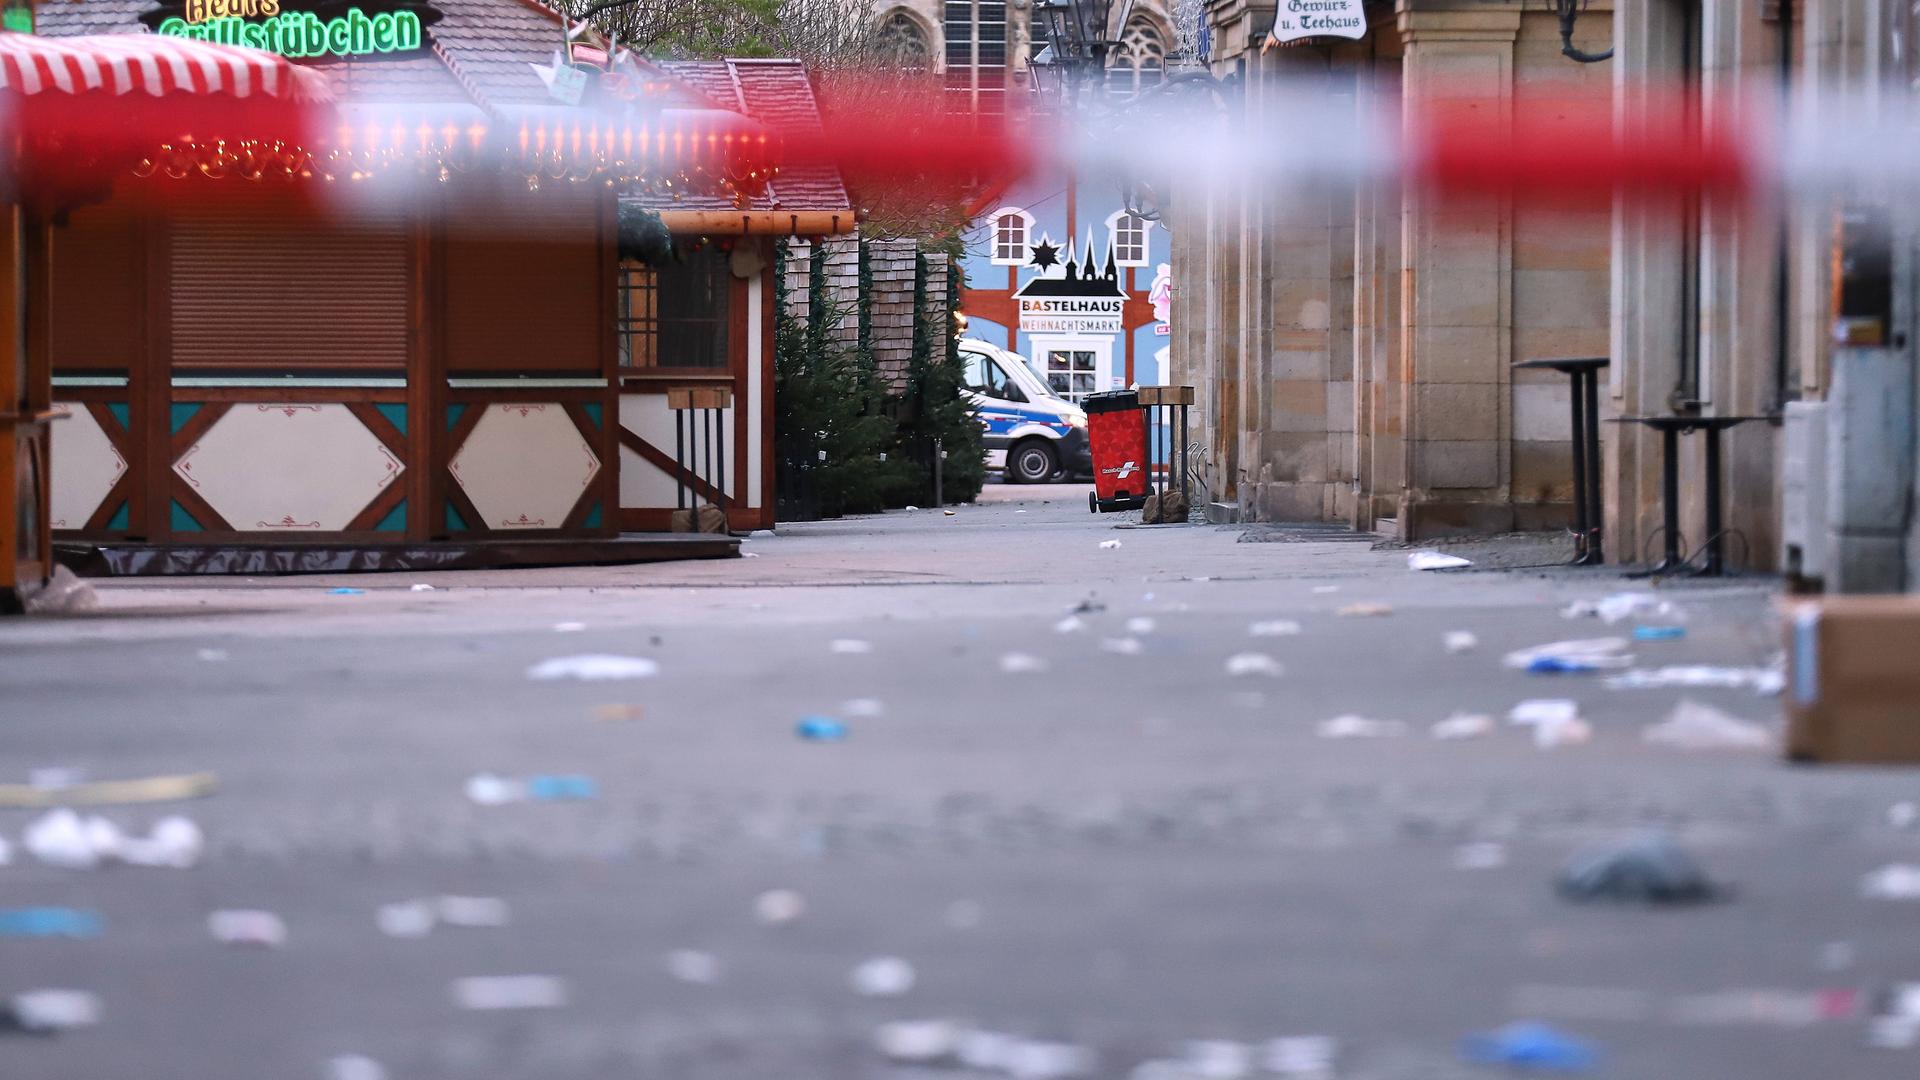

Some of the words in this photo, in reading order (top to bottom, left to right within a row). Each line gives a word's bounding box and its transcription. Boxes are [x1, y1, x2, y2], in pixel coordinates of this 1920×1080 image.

[1282, 20, 1295, 30] u.
[1300, 15, 1360, 31] Teehaus
[1022, 301, 1120, 312] BASTELHAUS
[1022, 320, 1120, 331] WEIHNACHTSMARKT
